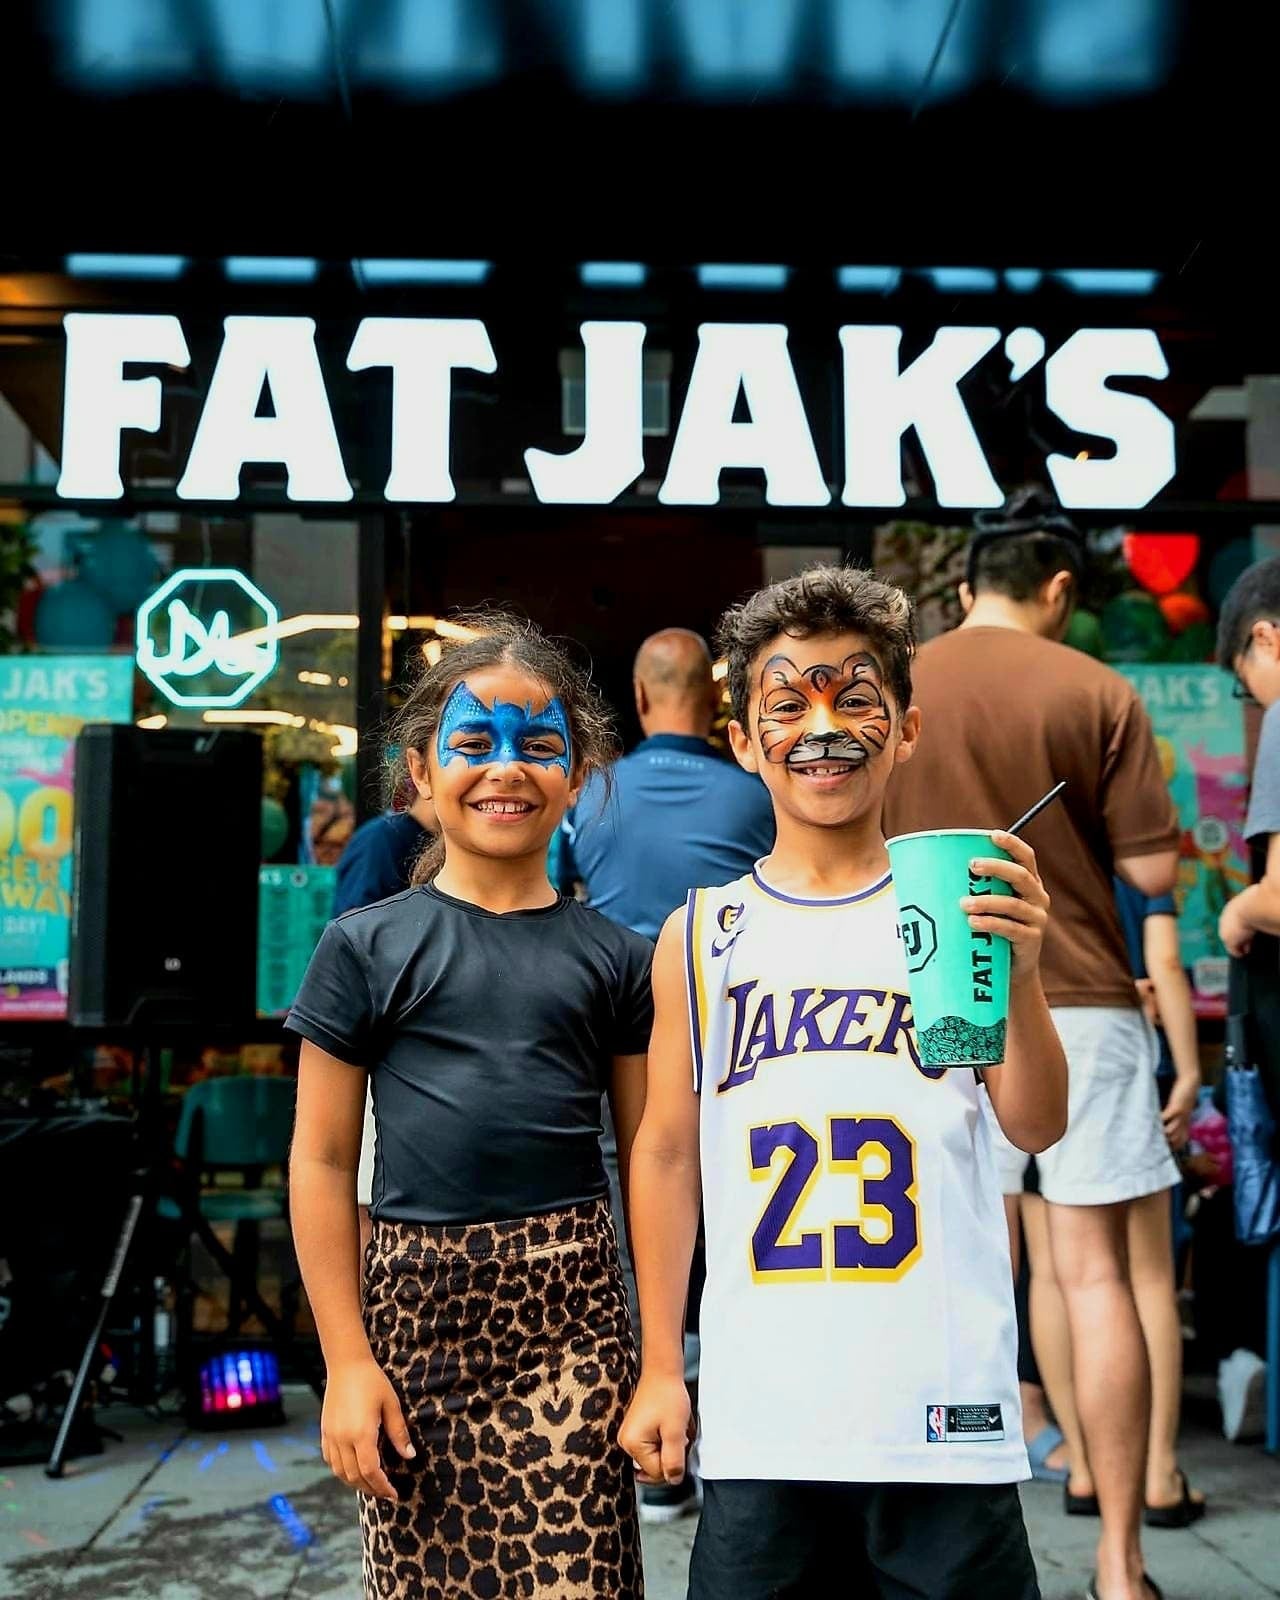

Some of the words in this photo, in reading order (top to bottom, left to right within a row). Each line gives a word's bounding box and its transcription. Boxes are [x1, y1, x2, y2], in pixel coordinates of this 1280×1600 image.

[56, 312, 498, 503] FAT
[523, 319, 1177, 510] JAK'S
[716, 978, 949, 1095] LAKER
[972, 949, 994, 1003] FAT
[747, 1112, 923, 1285] 23
